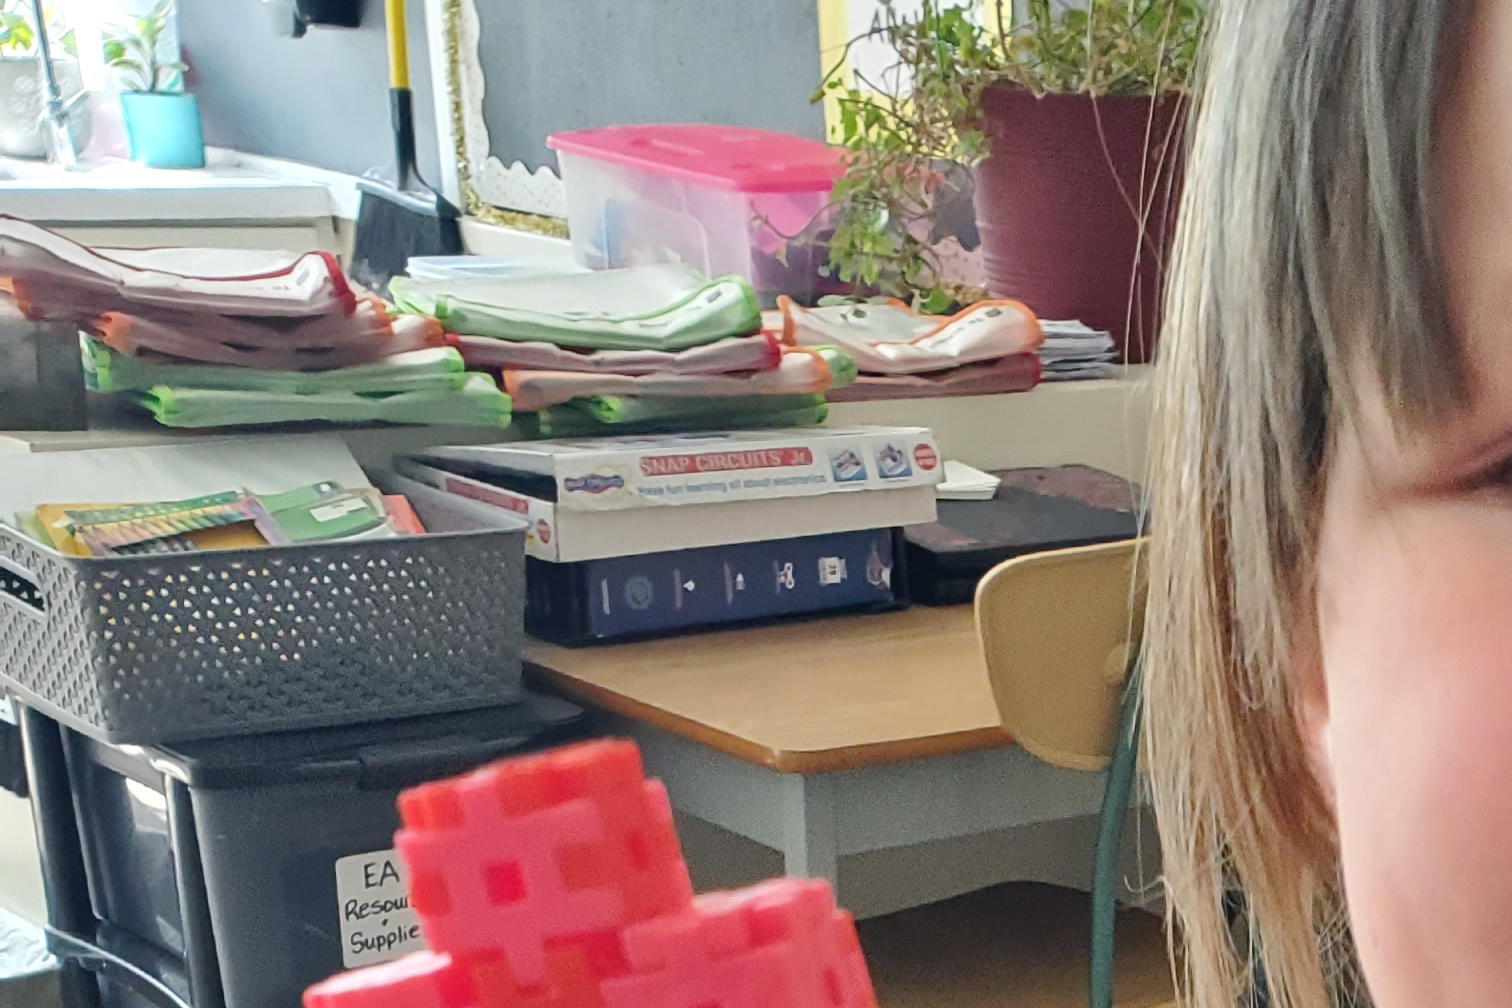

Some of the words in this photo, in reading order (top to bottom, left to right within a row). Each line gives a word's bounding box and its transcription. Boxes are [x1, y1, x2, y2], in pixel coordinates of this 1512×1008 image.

[640, 455, 689, 475] SNAP
[695, 450, 781, 472] CIRCUITS
[363, 860, 400, 890] EA
[344, 895, 411, 921] Resour
[350, 924, 420, 954] Supplie
